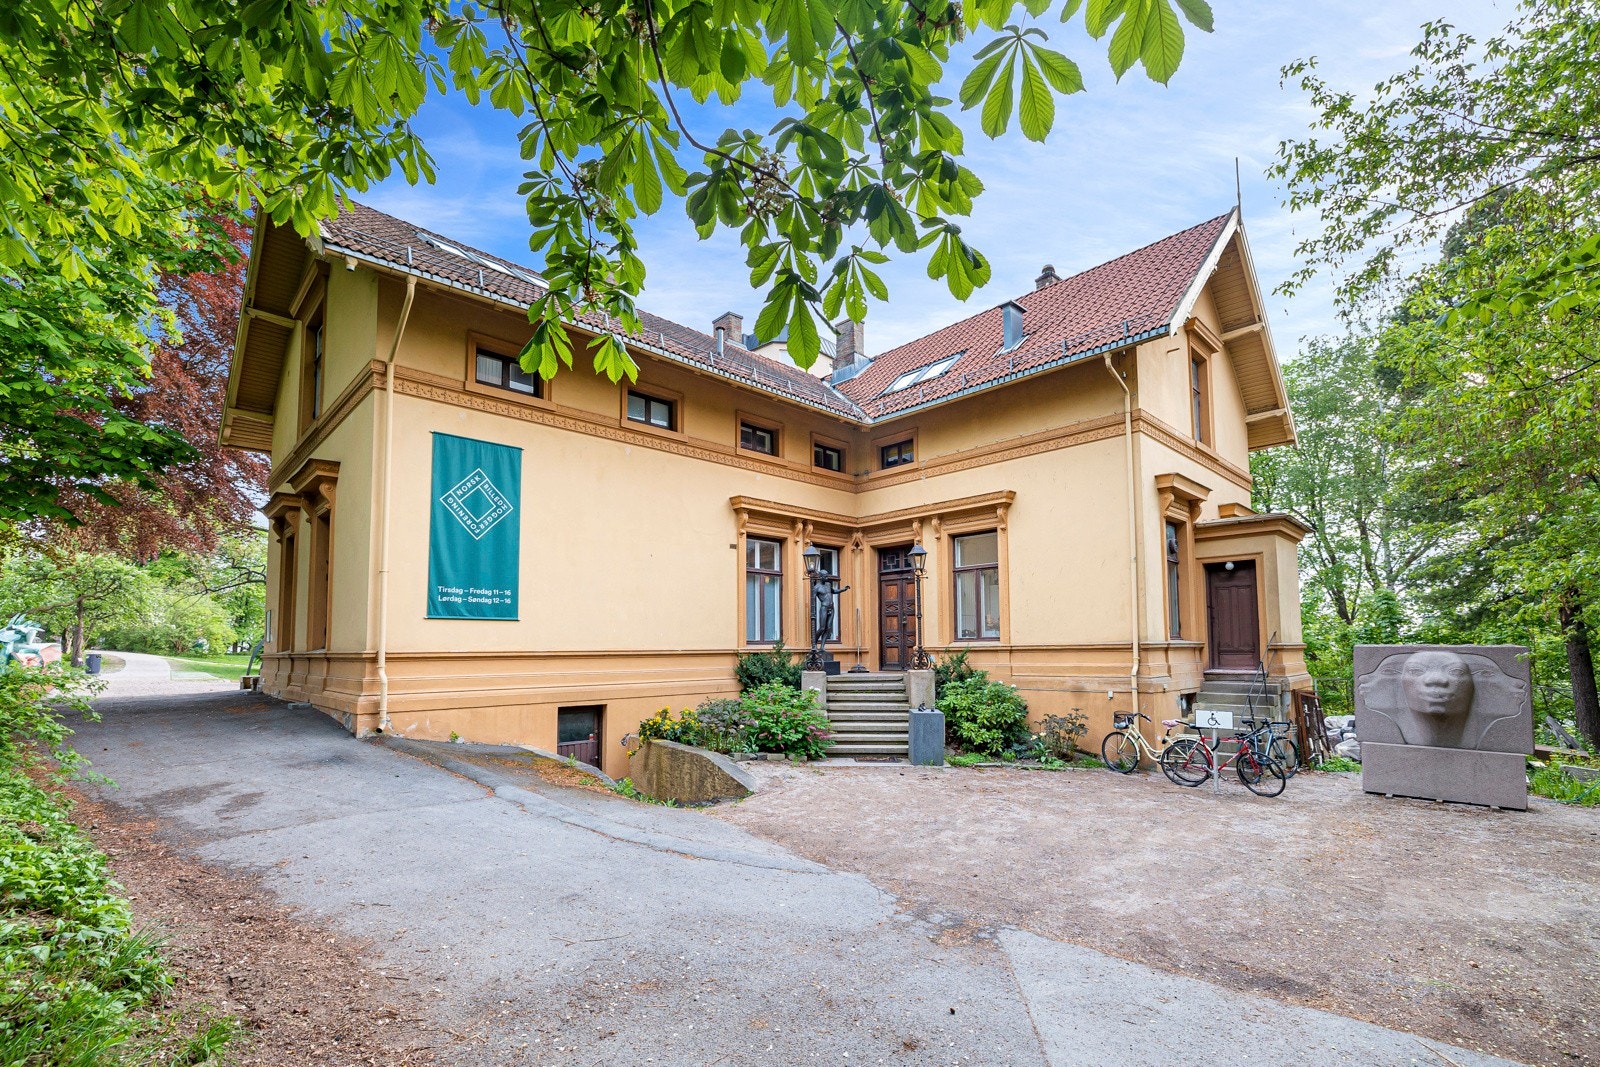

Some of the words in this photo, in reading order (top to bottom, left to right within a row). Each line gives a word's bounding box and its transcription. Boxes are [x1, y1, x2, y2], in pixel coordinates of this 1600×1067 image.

[456, 475, 481, 496] NORSK
[437, 586, 463, 595] Tirsdag
[469, 587, 492, 596] Fredag
[438, 595, 462, 603] Lørdag
[468, 596, 492, 604] Søndag
